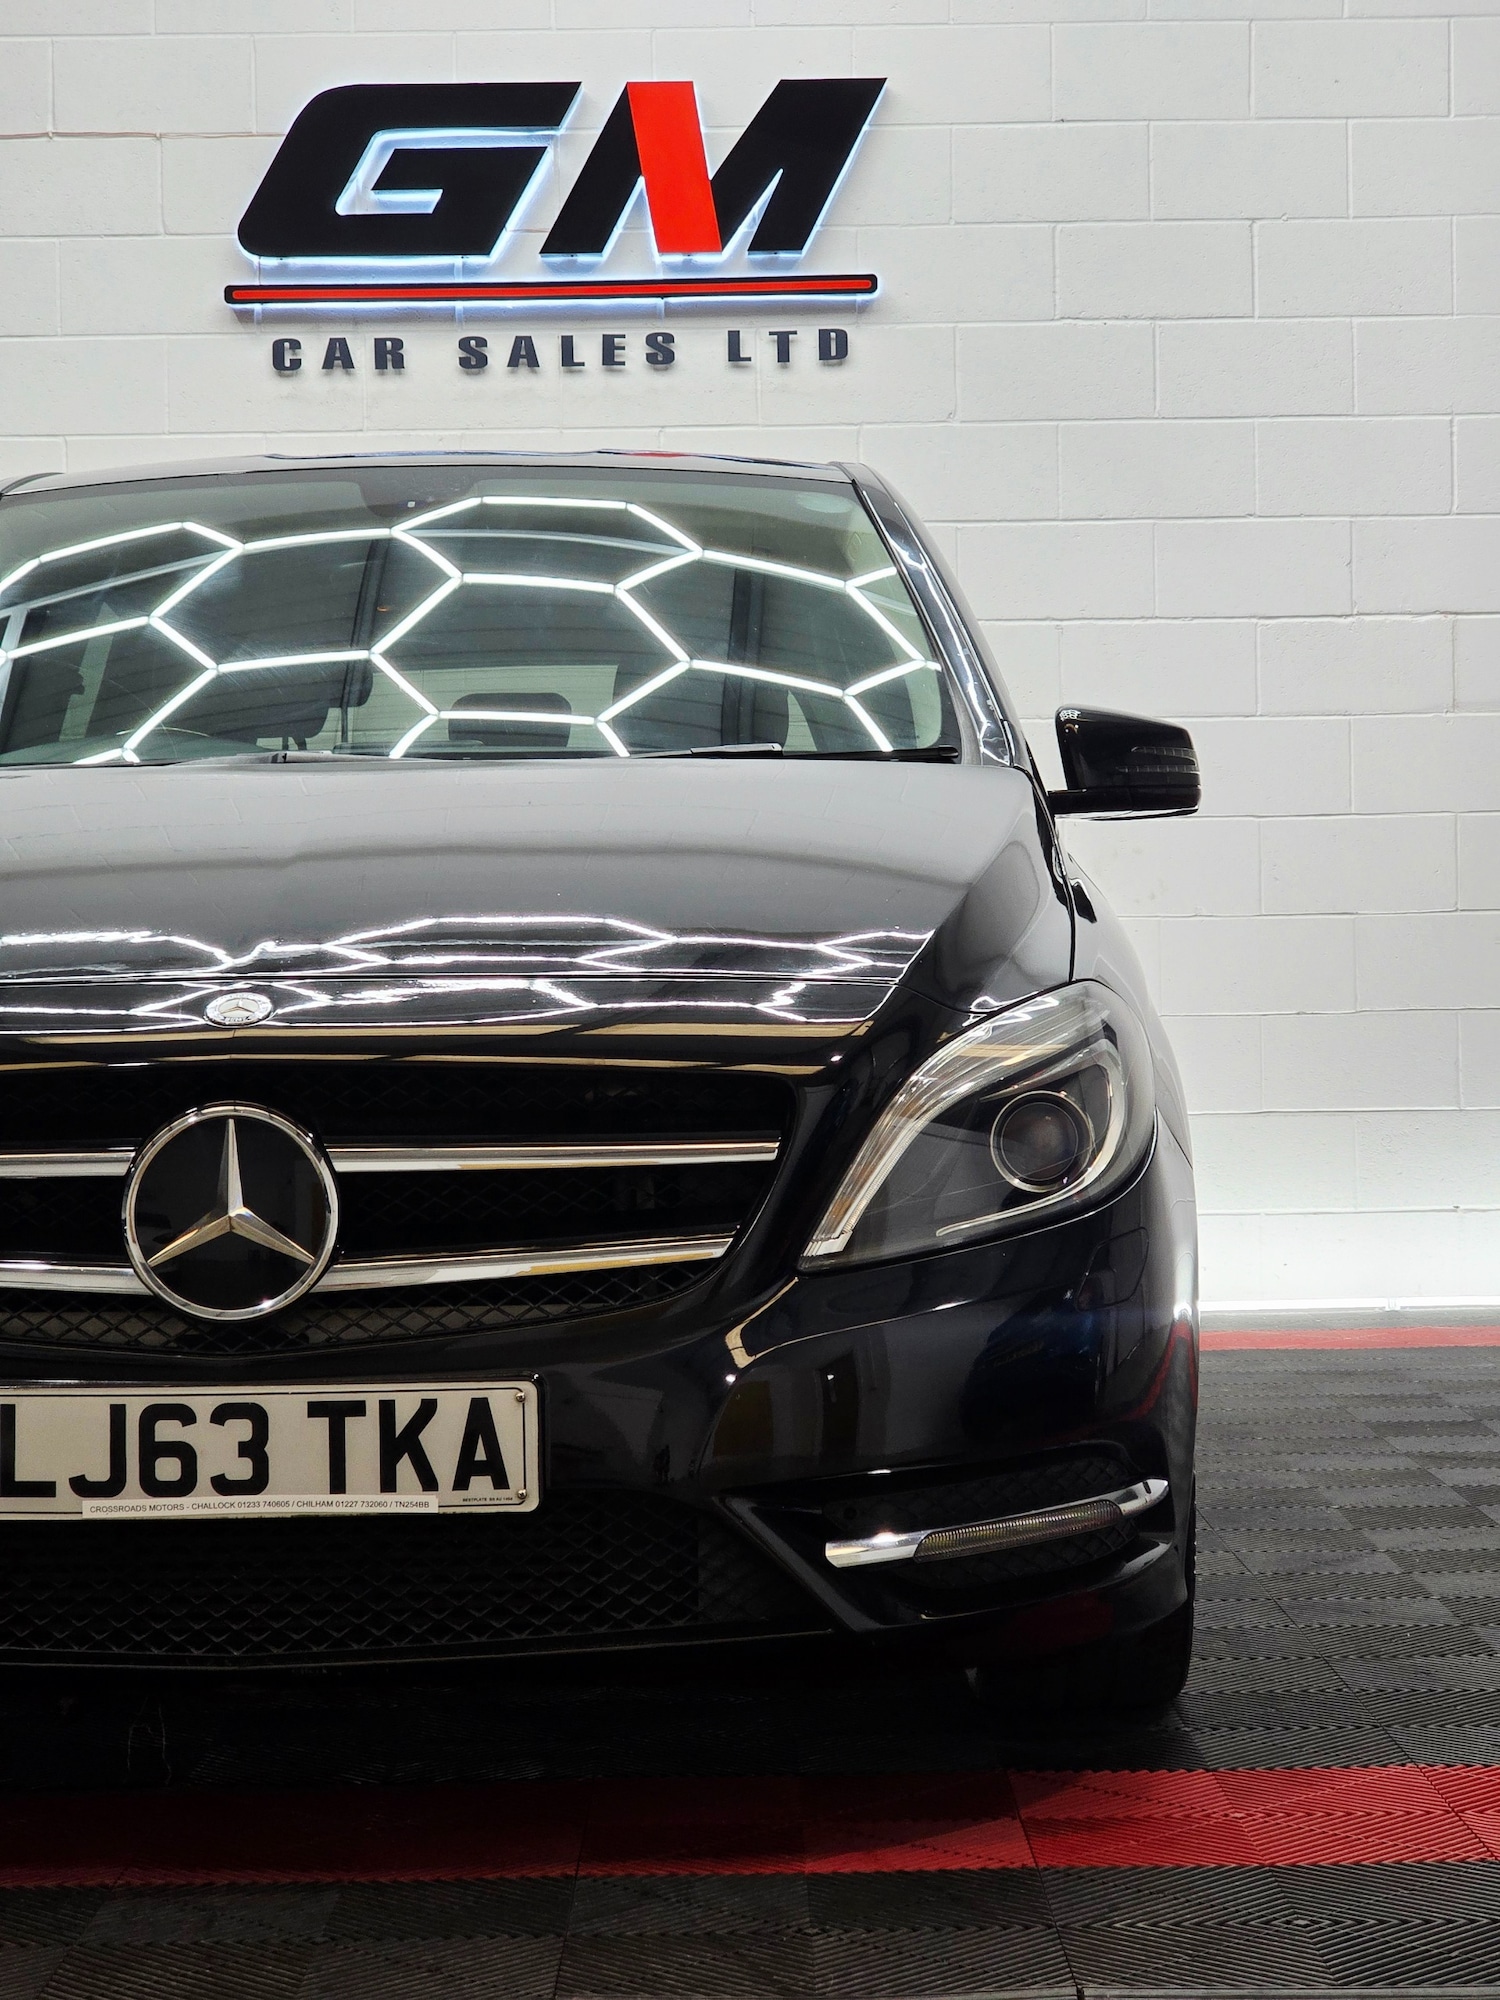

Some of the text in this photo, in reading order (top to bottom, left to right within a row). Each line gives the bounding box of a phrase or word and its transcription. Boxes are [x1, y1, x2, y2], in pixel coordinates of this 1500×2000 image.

[238, 78, 887, 257] GM
[272, 328, 850, 372] CAR SALES LTD
[0, 1397, 510, 1498] LJ63 TKA
[89, 1504, 147, 1513] CROSSROADS
[149, 1503, 185, 1512] MOTORS
[191, 1501, 236, 1510] CHALLOCK
[237, 1501, 260, 1509] 01233
[262, 1500, 291, 1508] 740605
[296, 1500, 334, 1508] CHILHAM
[335, 1500, 359, 1508] 01227
[360, 1500, 388, 1508] 732060
[394, 1500, 430, 1509] TN254BB
